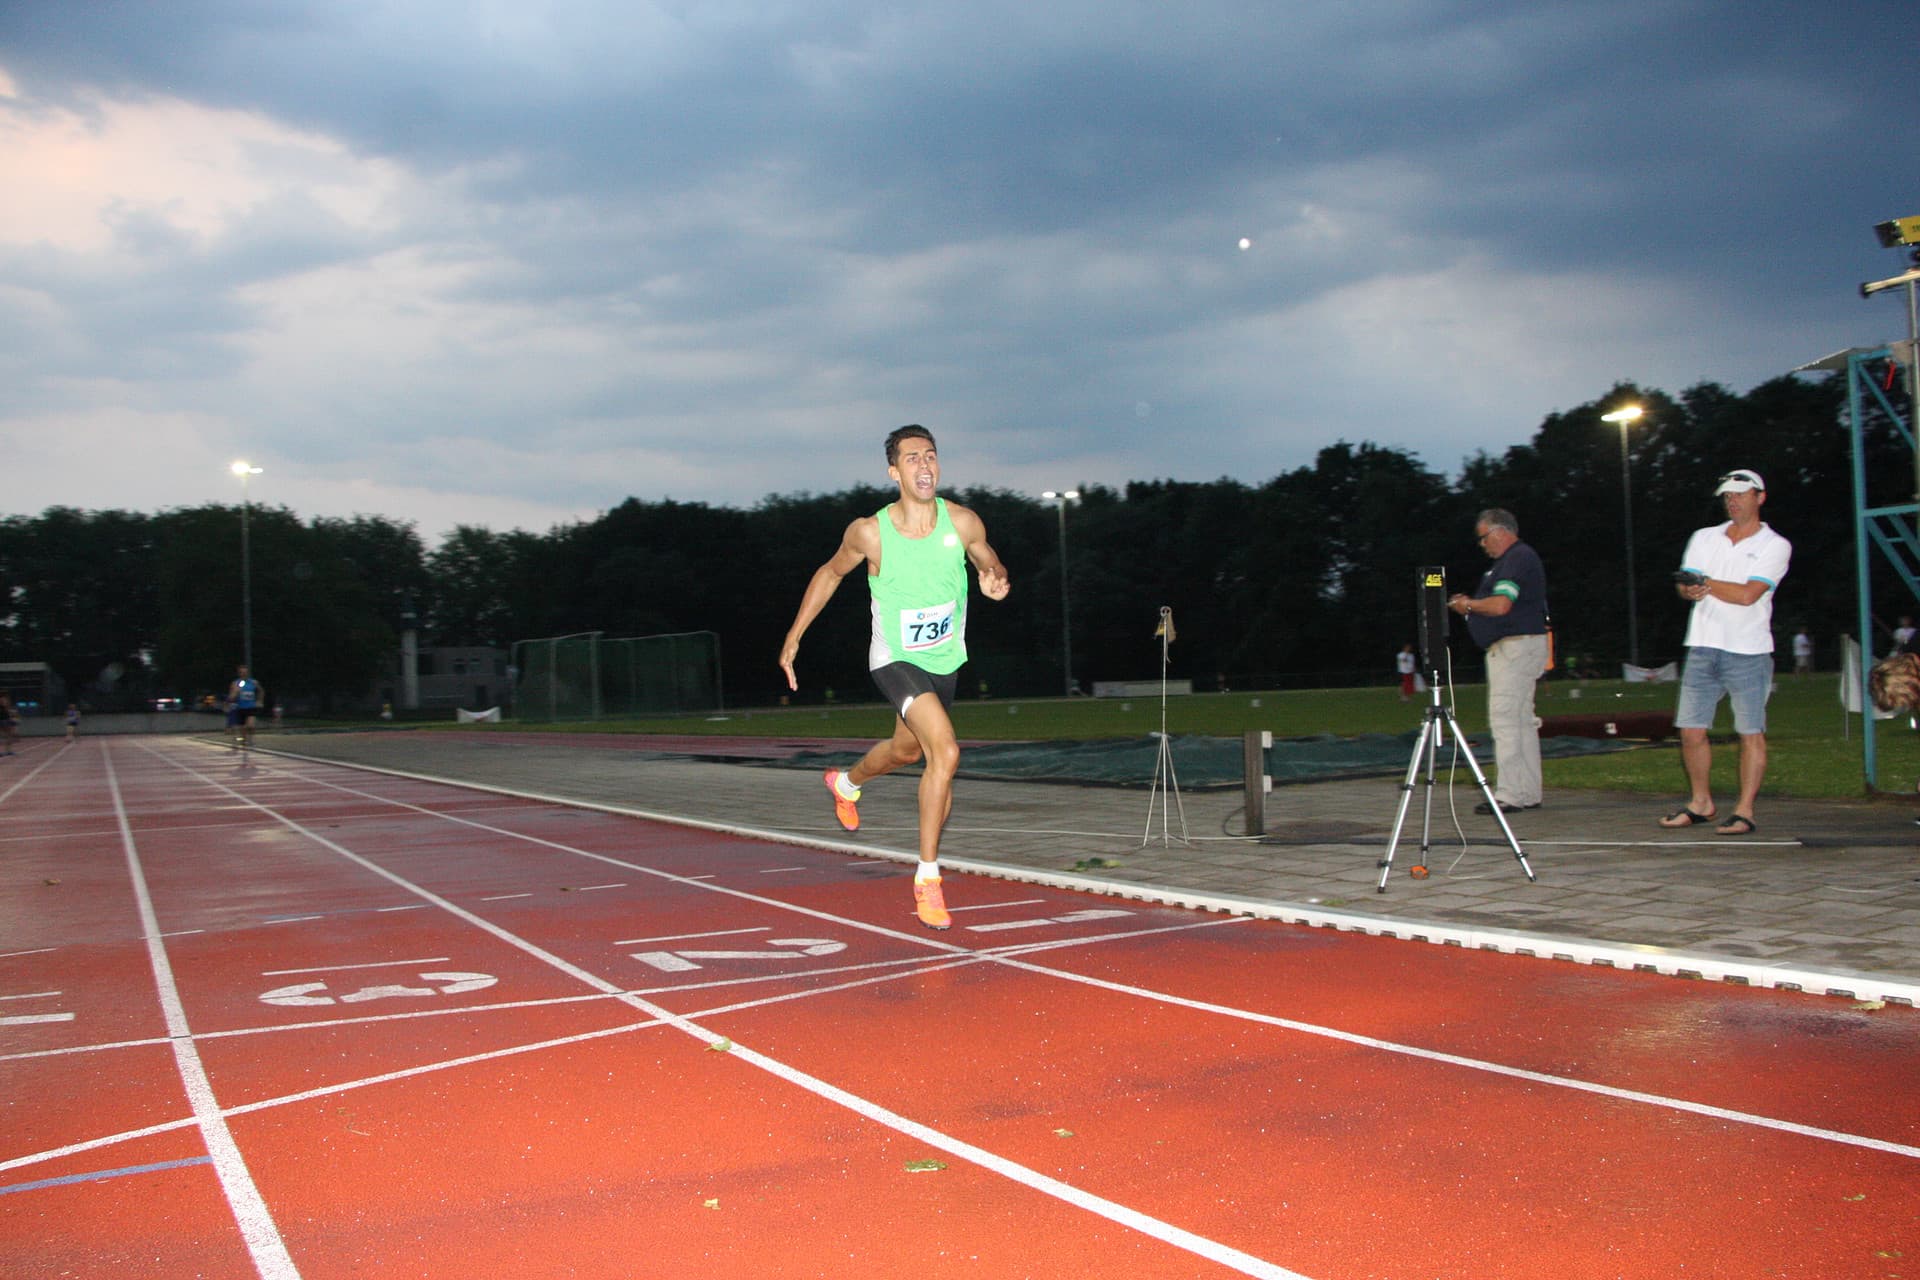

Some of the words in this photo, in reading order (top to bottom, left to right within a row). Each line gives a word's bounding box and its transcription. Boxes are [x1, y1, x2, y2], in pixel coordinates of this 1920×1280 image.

[909, 616, 950, 642] 736
[964, 909, 1137, 933] 1
[629, 938, 848, 973] 2
[259, 971, 499, 1007] 3
